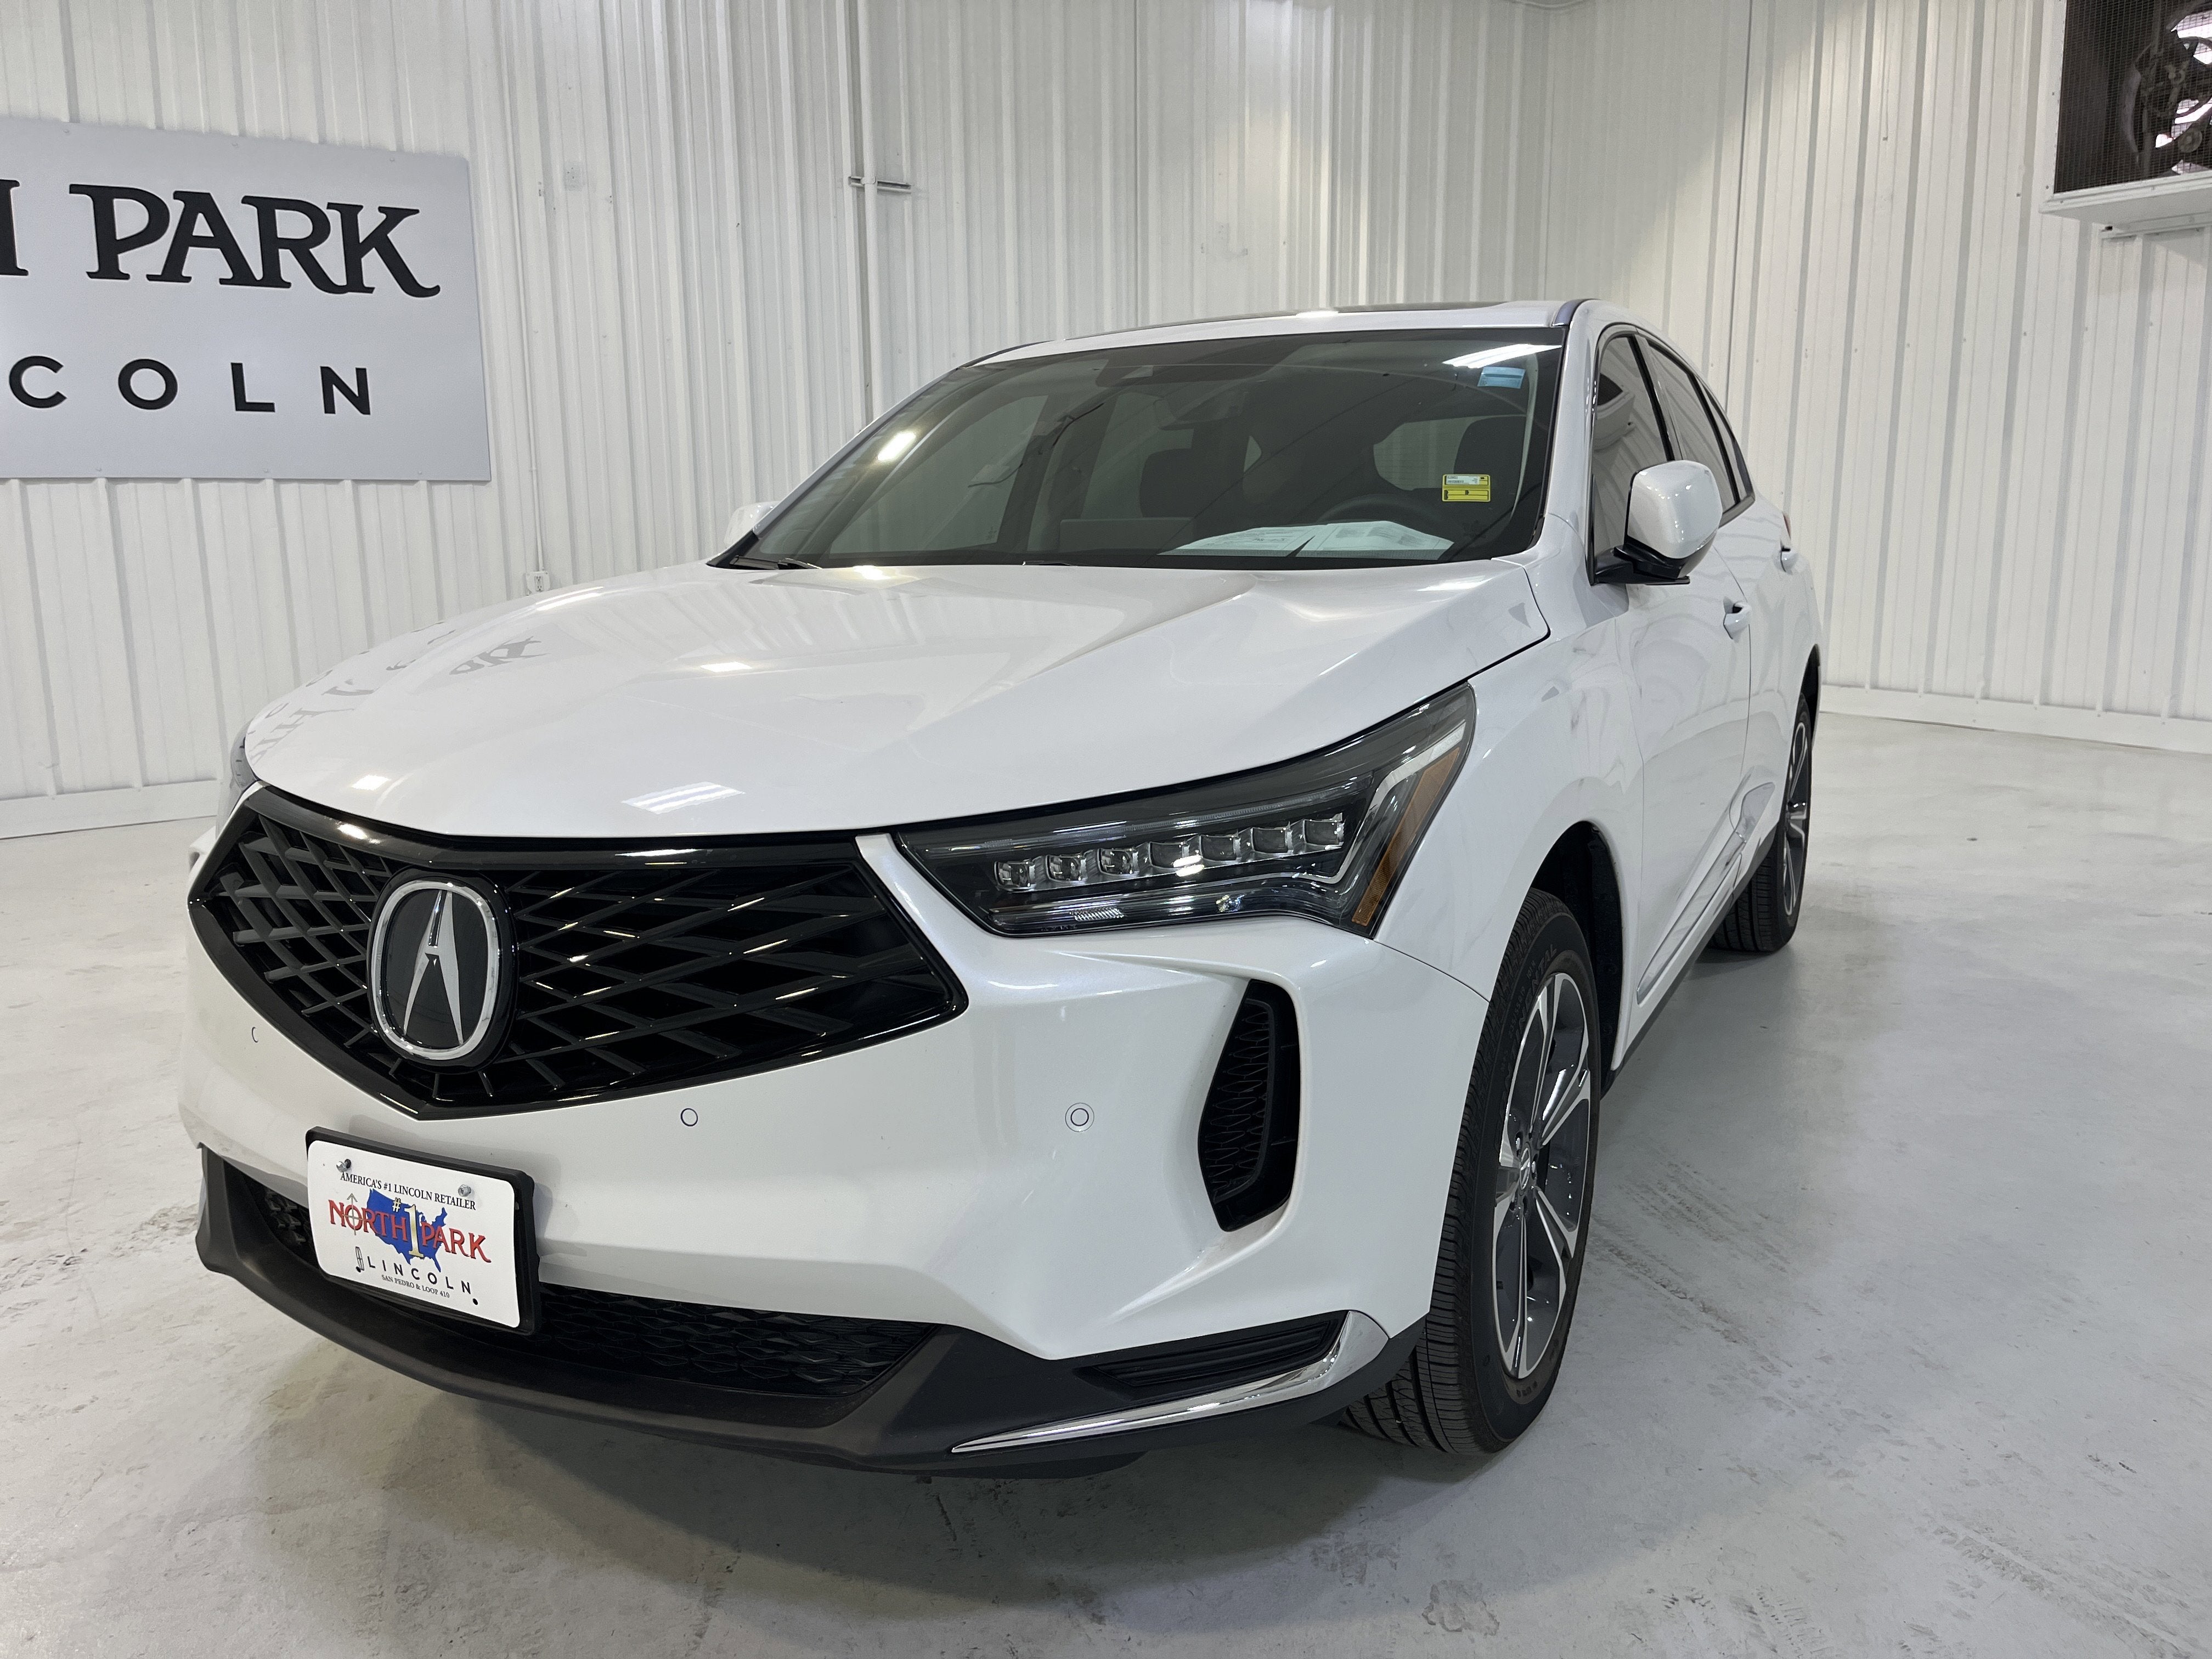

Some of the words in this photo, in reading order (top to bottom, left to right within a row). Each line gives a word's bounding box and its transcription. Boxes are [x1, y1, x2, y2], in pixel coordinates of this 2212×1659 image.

[69, 183, 441, 298] PARK
[340, 1172, 382, 1189] AMERICA'S
[383, 1182, 392, 1192] #1
[394, 1184, 433, 1200] LINCOLN
[435, 1193, 476, 1211] RETAILER
[328, 1199, 408, 1242] NORTH
[420, 1221, 492, 1263] PARK
[368, 1256, 471, 1295] LINCOLN
[381, 1274, 394, 1283] SAN
[394, 1278, 415, 1289] PEDRO
[422, 1285, 438, 1296] LOOP
[440, 1290, 450, 1299] 410
